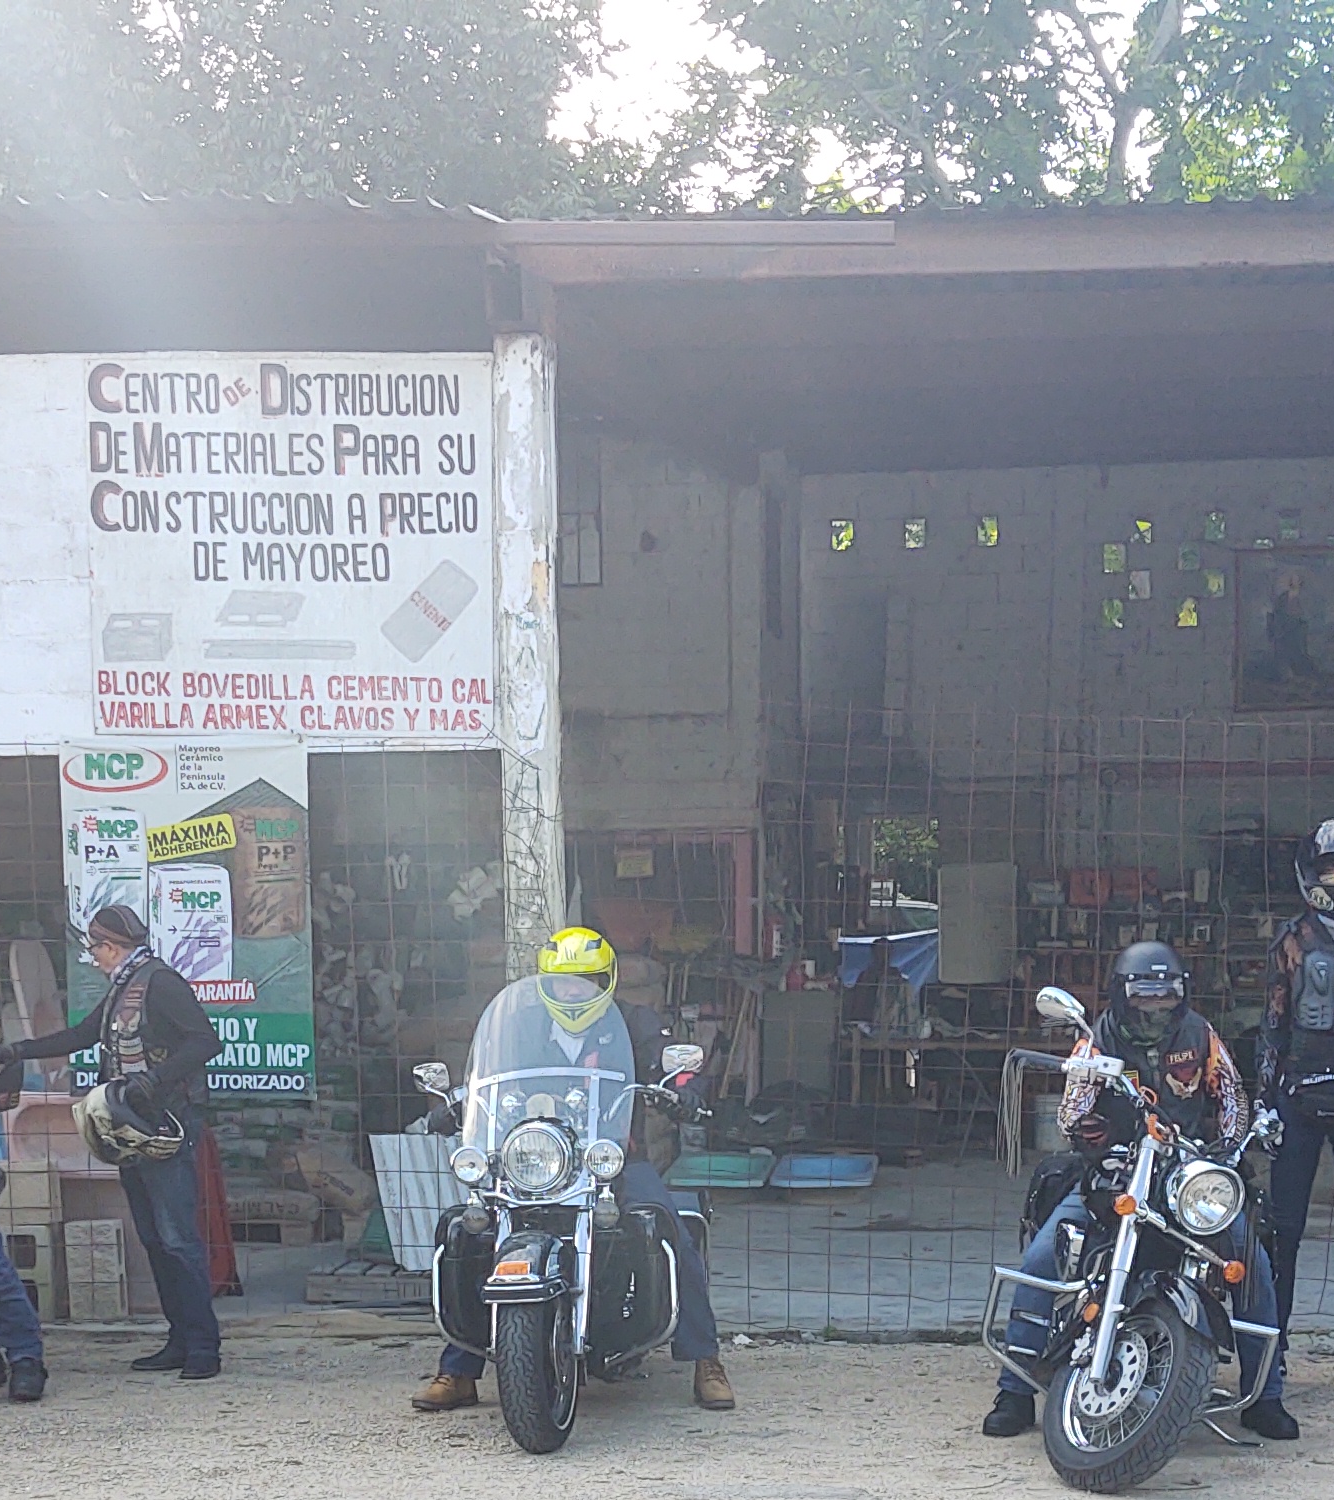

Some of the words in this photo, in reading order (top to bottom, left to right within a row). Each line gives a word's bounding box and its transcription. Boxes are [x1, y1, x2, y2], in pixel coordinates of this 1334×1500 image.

[88, 363, 220, 414] CENTRO
[223, 377, 252, 407] DE
[260, 364, 460, 417] DISTRIBUCION
[89, 421, 128, 474] DE
[133, 422, 325, 477] MATERIALES
[333, 424, 421, 475] PARA
[438, 434, 476, 475] SU
[90, 480, 335, 536] CONSTRUCCION
[347, 493, 367, 534] A
[379, 492, 479, 537] PRECIO
[193, 541, 229, 582] DE
[242, 542, 391, 583] MAYOREO
[410, 590, 453, 633] CEMENTO
[98, 670, 171, 697] BLOCK
[182, 672, 315, 701] BOVEDILLA
[327, 675, 443, 703] CEMENTO
[452, 678, 493, 704] CAL
[99, 701, 194, 728] VARILLA
[202, 703, 287, 730] ARMEX
[300, 705, 395, 731] CLAVOS
[404, 708, 420, 731] Y
[429, 709, 483, 731] MAS
[178, 744, 221, 754] Mayoreo
[179, 753, 224, 762] Cerámico
[84, 753, 144, 780] MCP
[179, 763, 192, 772] de
[193, 763, 203, 772] la
[197, 782, 209, 791] de
[97, 819, 139, 839] MCP
[147, 820, 229, 853] ¡MÁXIMA
[254, 818, 300, 840] MCP
[84, 844, 120, 861] P+A
[153, 833, 233, 859] ADHERENCIA!
[257, 845, 297, 862] P+P
[181, 891, 222, 909] MCP
[243, 1017, 258, 1041] Y
[267, 1043, 310, 1067] MCP
[1168, 1050, 1194, 1064] FELIPE
